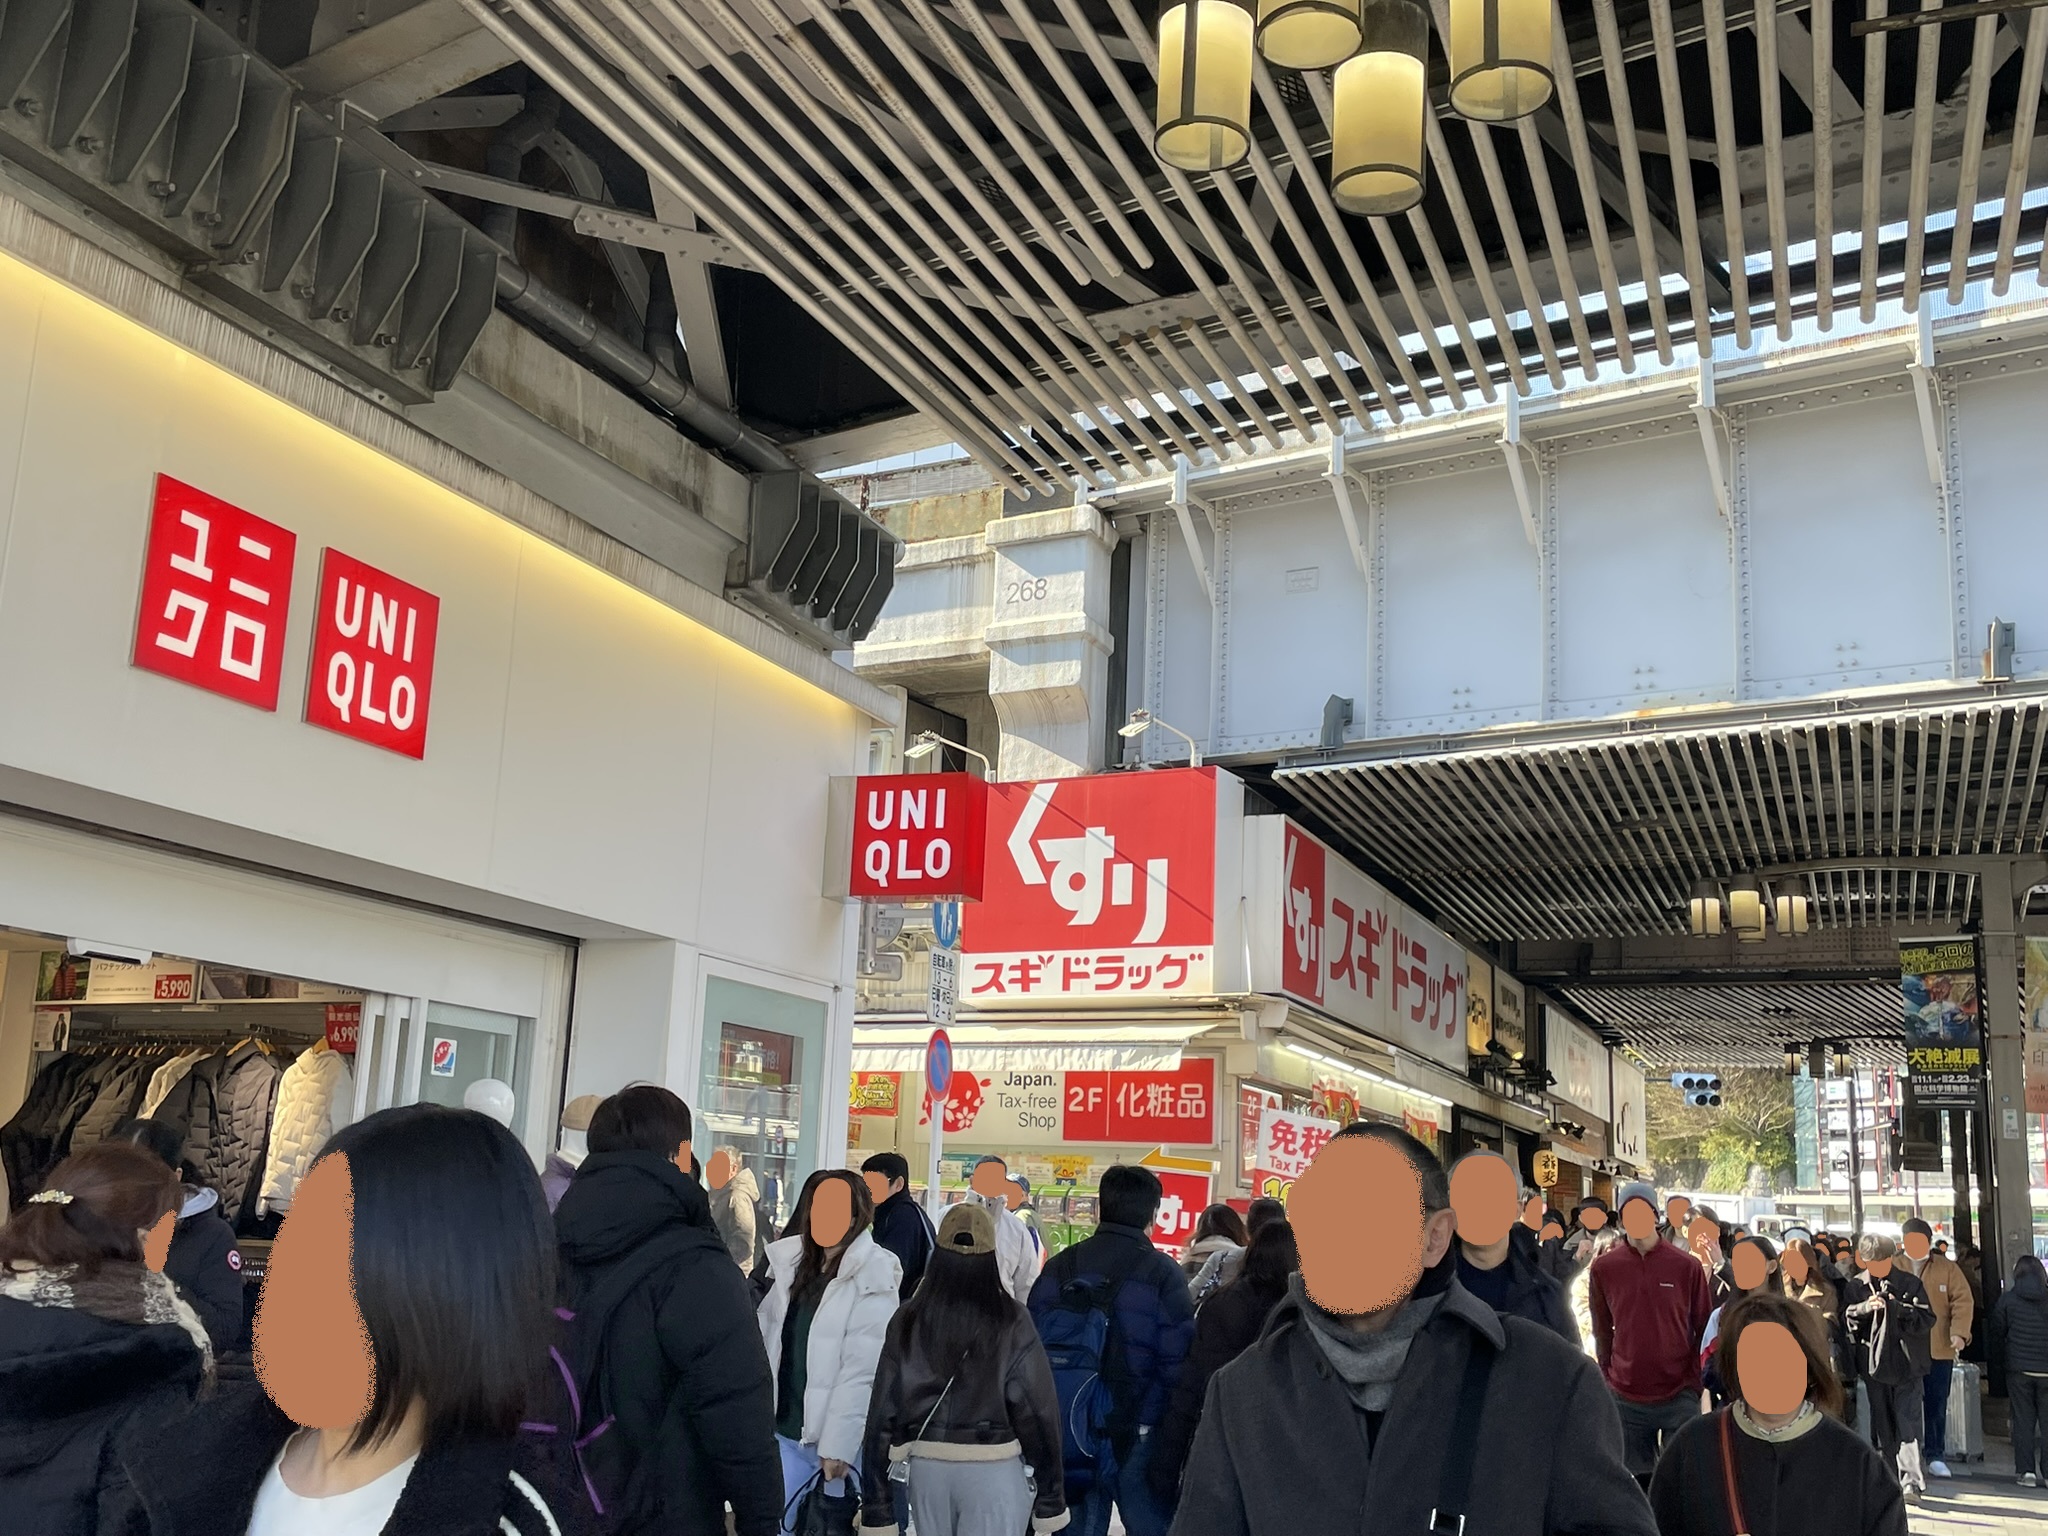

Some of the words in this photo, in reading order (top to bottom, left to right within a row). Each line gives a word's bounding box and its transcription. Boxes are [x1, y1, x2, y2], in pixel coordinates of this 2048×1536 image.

[169, 510, 271, 606] ユニ
[1006, 578, 1048, 604] 268
[155, 588, 268, 683] クロ
[334, 576, 418, 663] UNI
[326, 651, 417, 732] QLO
[867, 788, 946, 831] UNI
[864, 837, 952, 888] QLO
[1007, 783, 1168, 944] くすり
[1283, 834, 1325, 998] くすり
[156, 980, 191, 999] ¥5,990
[971, 952, 1206, 994] スギドラッグ
[1329, 897, 1464, 1040] スギドラッグ
[1908, 1047, 1980, 1066] 大絶滅展
[997, 1092, 1058, 1110] Tax-free
[1003, 1071, 1058, 1089] Japan.
[1068, 1086, 1103, 1113] 2F
[1116, 1082, 1207, 1120] 化粧品
[1018, 1112, 1057, 1131] Shop
[1269, 1155, 1291, 1173] Tax
